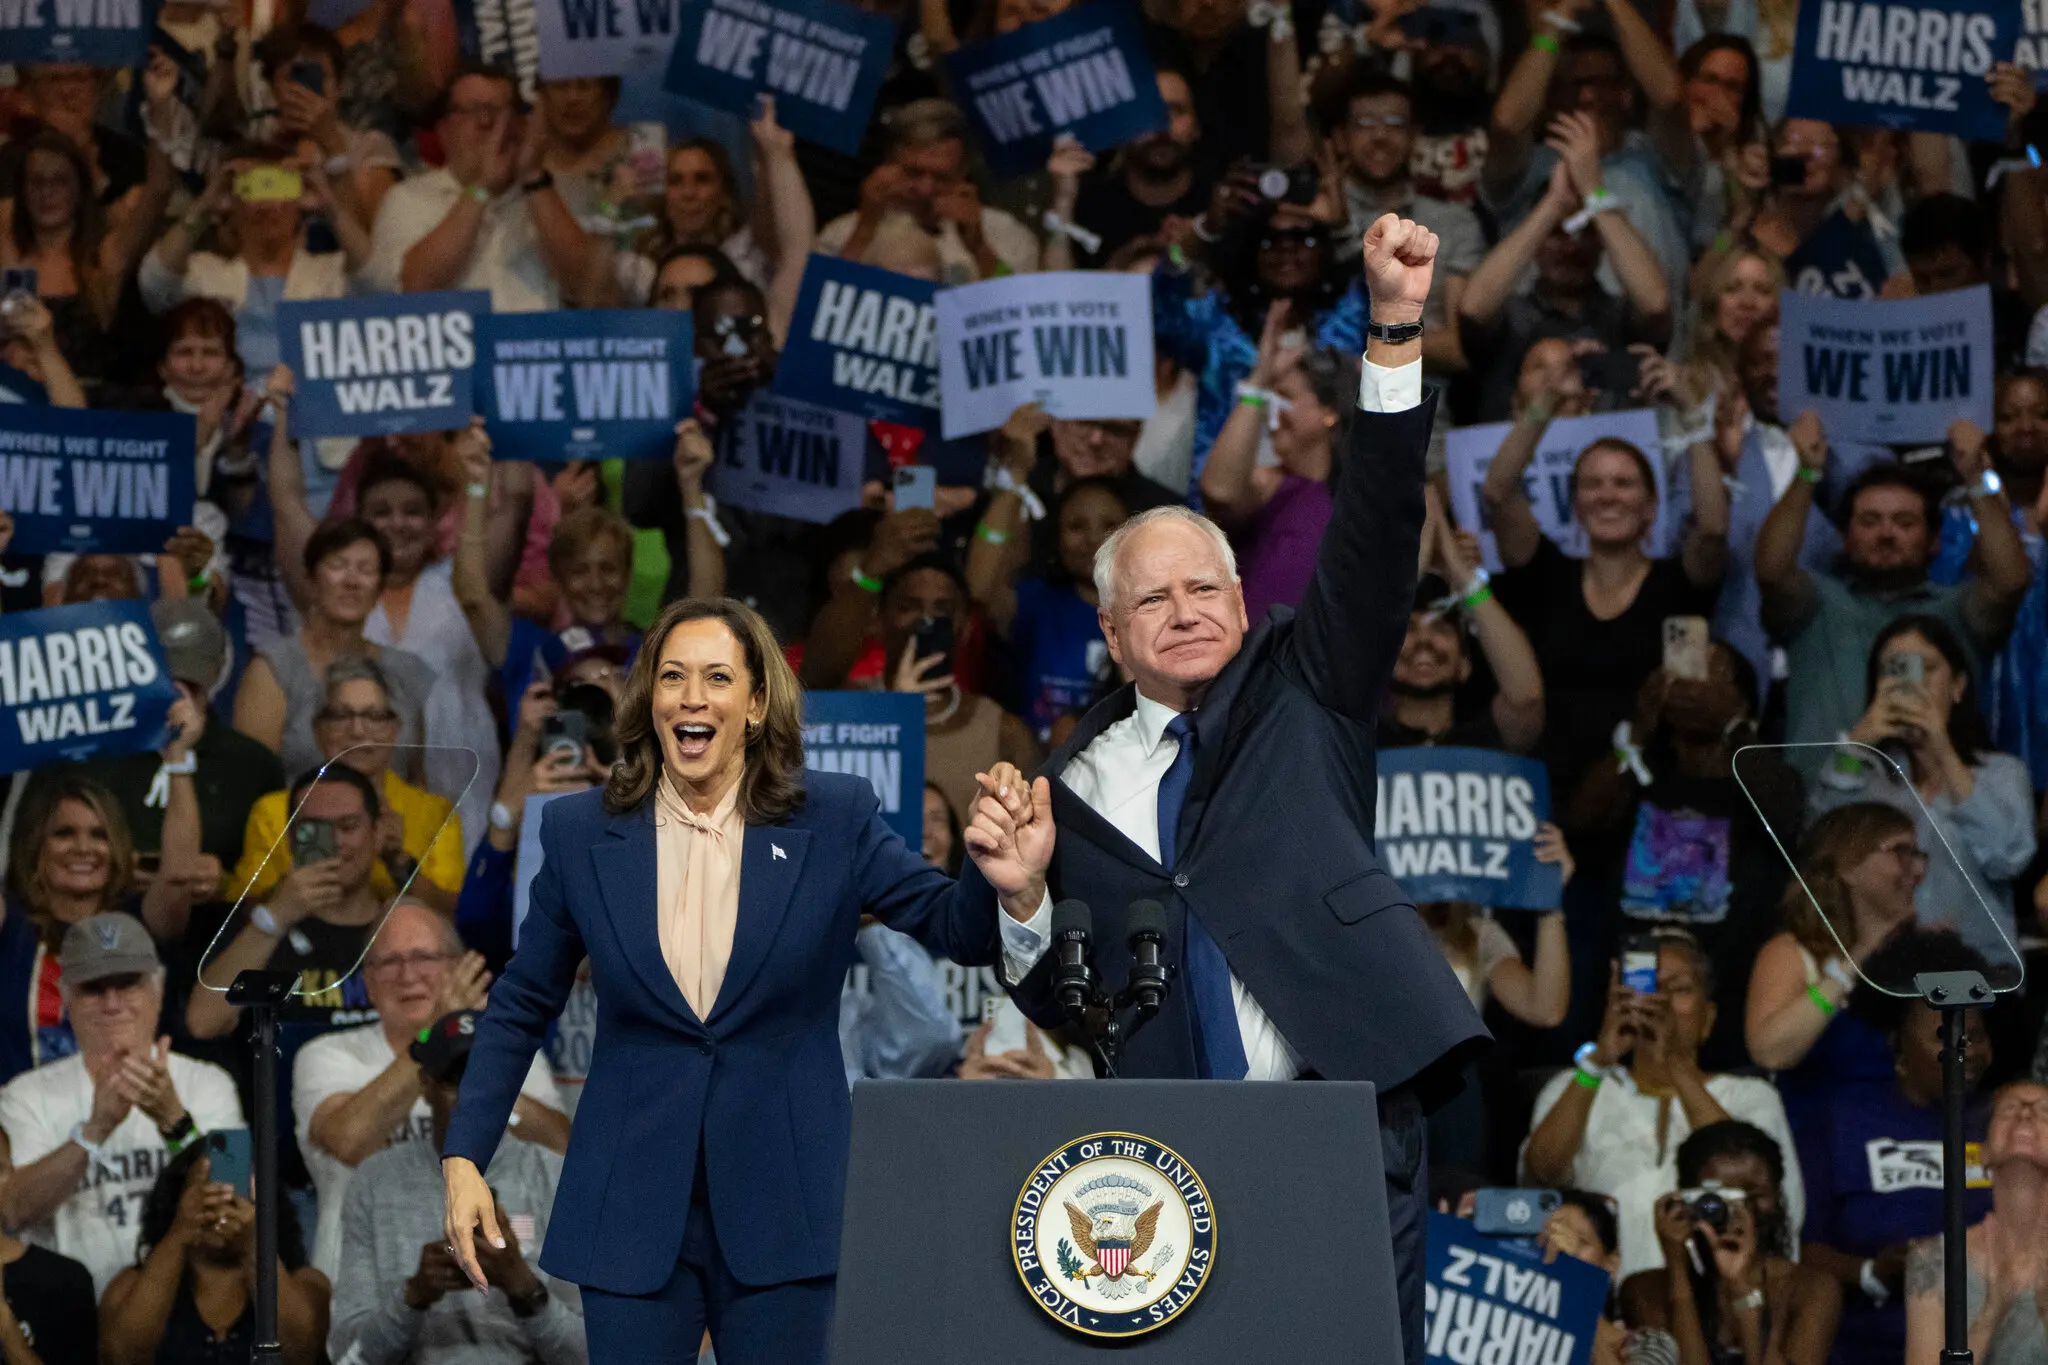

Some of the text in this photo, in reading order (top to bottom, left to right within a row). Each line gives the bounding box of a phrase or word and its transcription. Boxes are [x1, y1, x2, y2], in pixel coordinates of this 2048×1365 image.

[696, 8, 768, 81] WE
[765, 31, 861, 113] WIN
[1814, 0, 1997, 77] HARRIS
[973, 45, 1137, 146] WE WIN
[1841, 65, 1962, 112] WALZ
[810, 279, 938, 370] HARR
[1028, 303, 1059, 318] WE
[1065, 302, 1120, 318] VOTE
[300, 310, 476, 380] HARRIS
[494, 336, 668, 359] WHEN WE FIGHT
[962, 325, 1128, 390] WE WIN
[1804, 342, 1970, 403] WE WIN
[333, 373, 455, 415] WALZ
[493, 360, 671, 422] WE WIN
[63, 436, 99, 458] WE
[102, 438, 170, 460] FIGHT
[756, 422, 841, 488] WIN
[0, 453, 170, 521] WE WIN
[16, 692, 138, 745] WALZ
[836, 723, 901, 745] FIGHT
[1385, 839, 1510, 880] WALZ
[1016, 1140, 1211, 1325] VICE PRESIDENT OF THE UNITED STATES
[1440, 1244, 1562, 1321] WALZ
